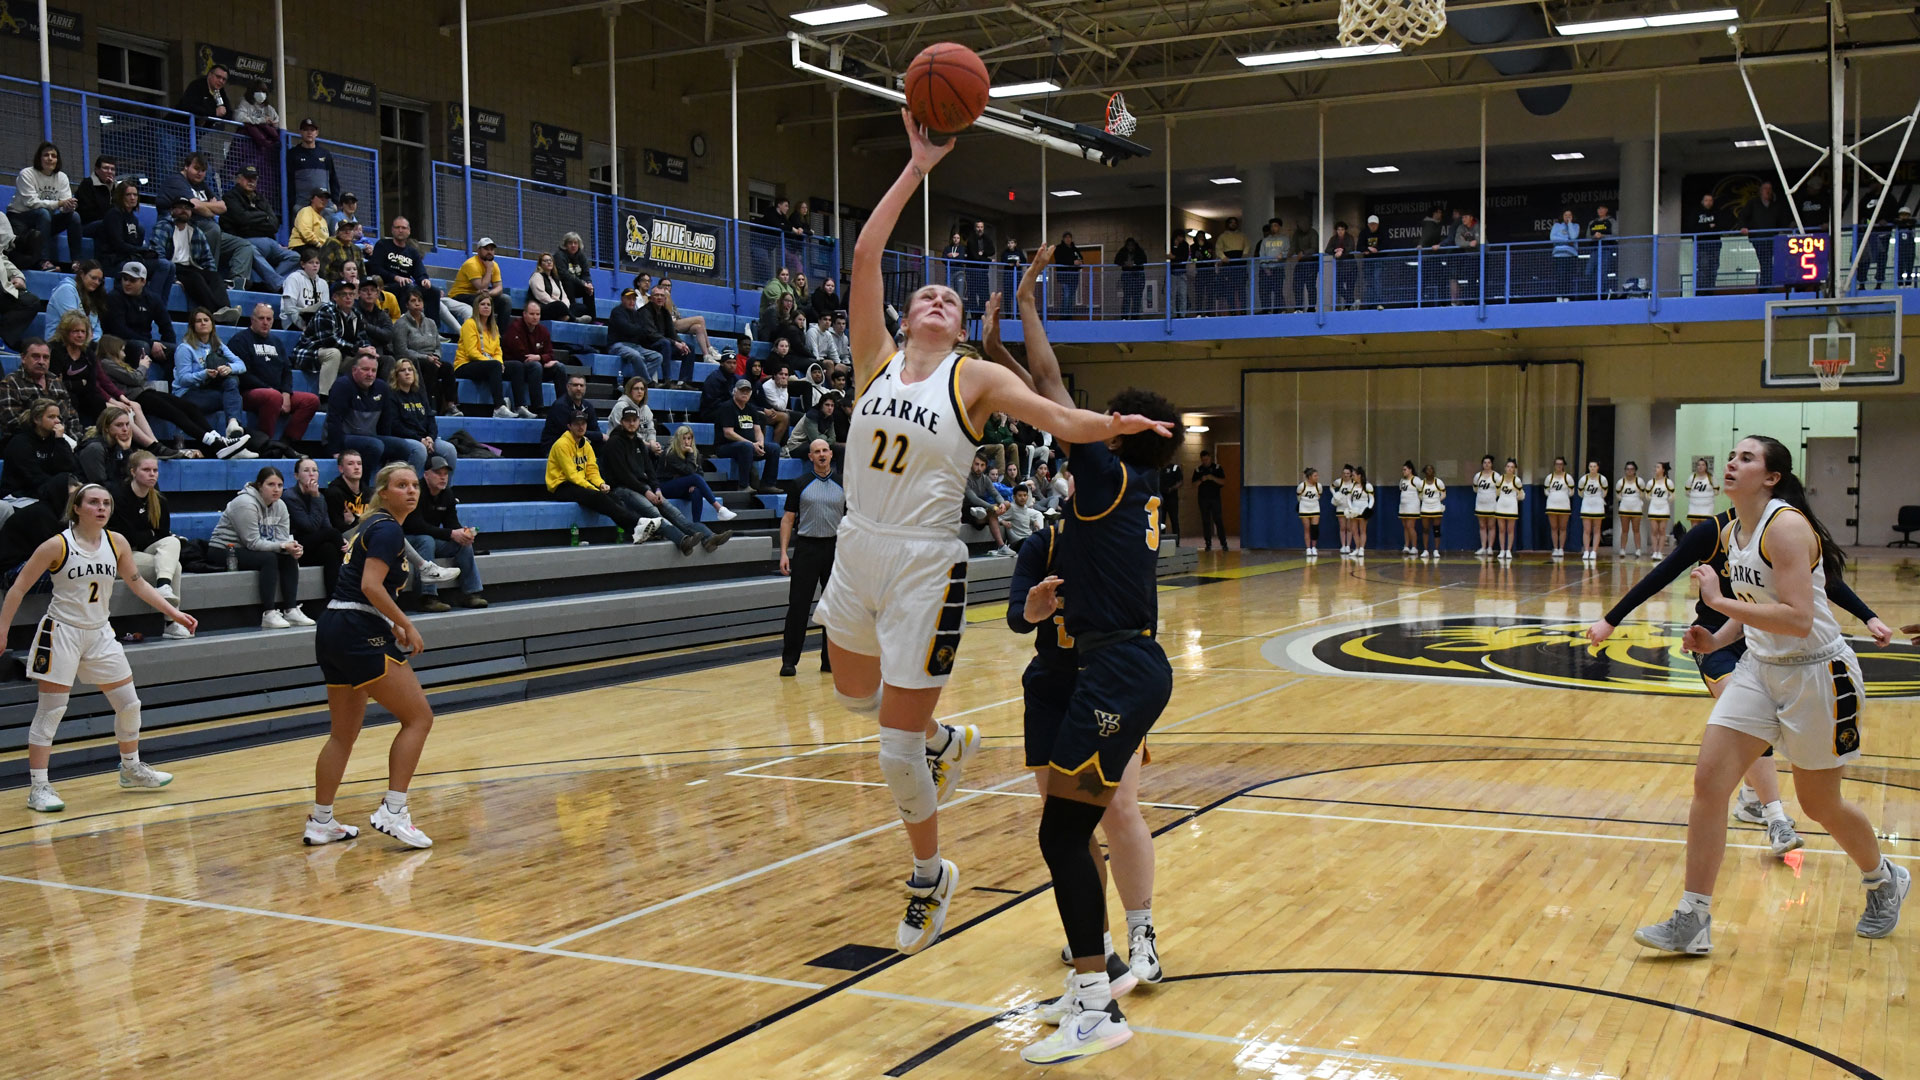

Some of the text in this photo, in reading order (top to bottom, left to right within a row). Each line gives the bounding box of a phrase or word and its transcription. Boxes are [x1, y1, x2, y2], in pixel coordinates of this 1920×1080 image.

[48, 13, 74, 28] LARKE
[238, 58, 266, 72] CLARKE
[345, 82, 370, 95] CLARKE
[1486, 195, 1528, 208] NTEGRITY
[1388, 226, 1423, 239] SERVAN
[651, 244, 714, 268] BENCHWARMERS
[1788, 237, 1825, 255] 5:04
[1800, 252, 1818, 280] 5
[862, 397, 941, 434] CLARKE
[870, 428, 911, 476] 22
[1733, 565, 1765, 588] ARKE
[88, 581, 99, 604] 2
[1094, 708, 1120, 736] WP
